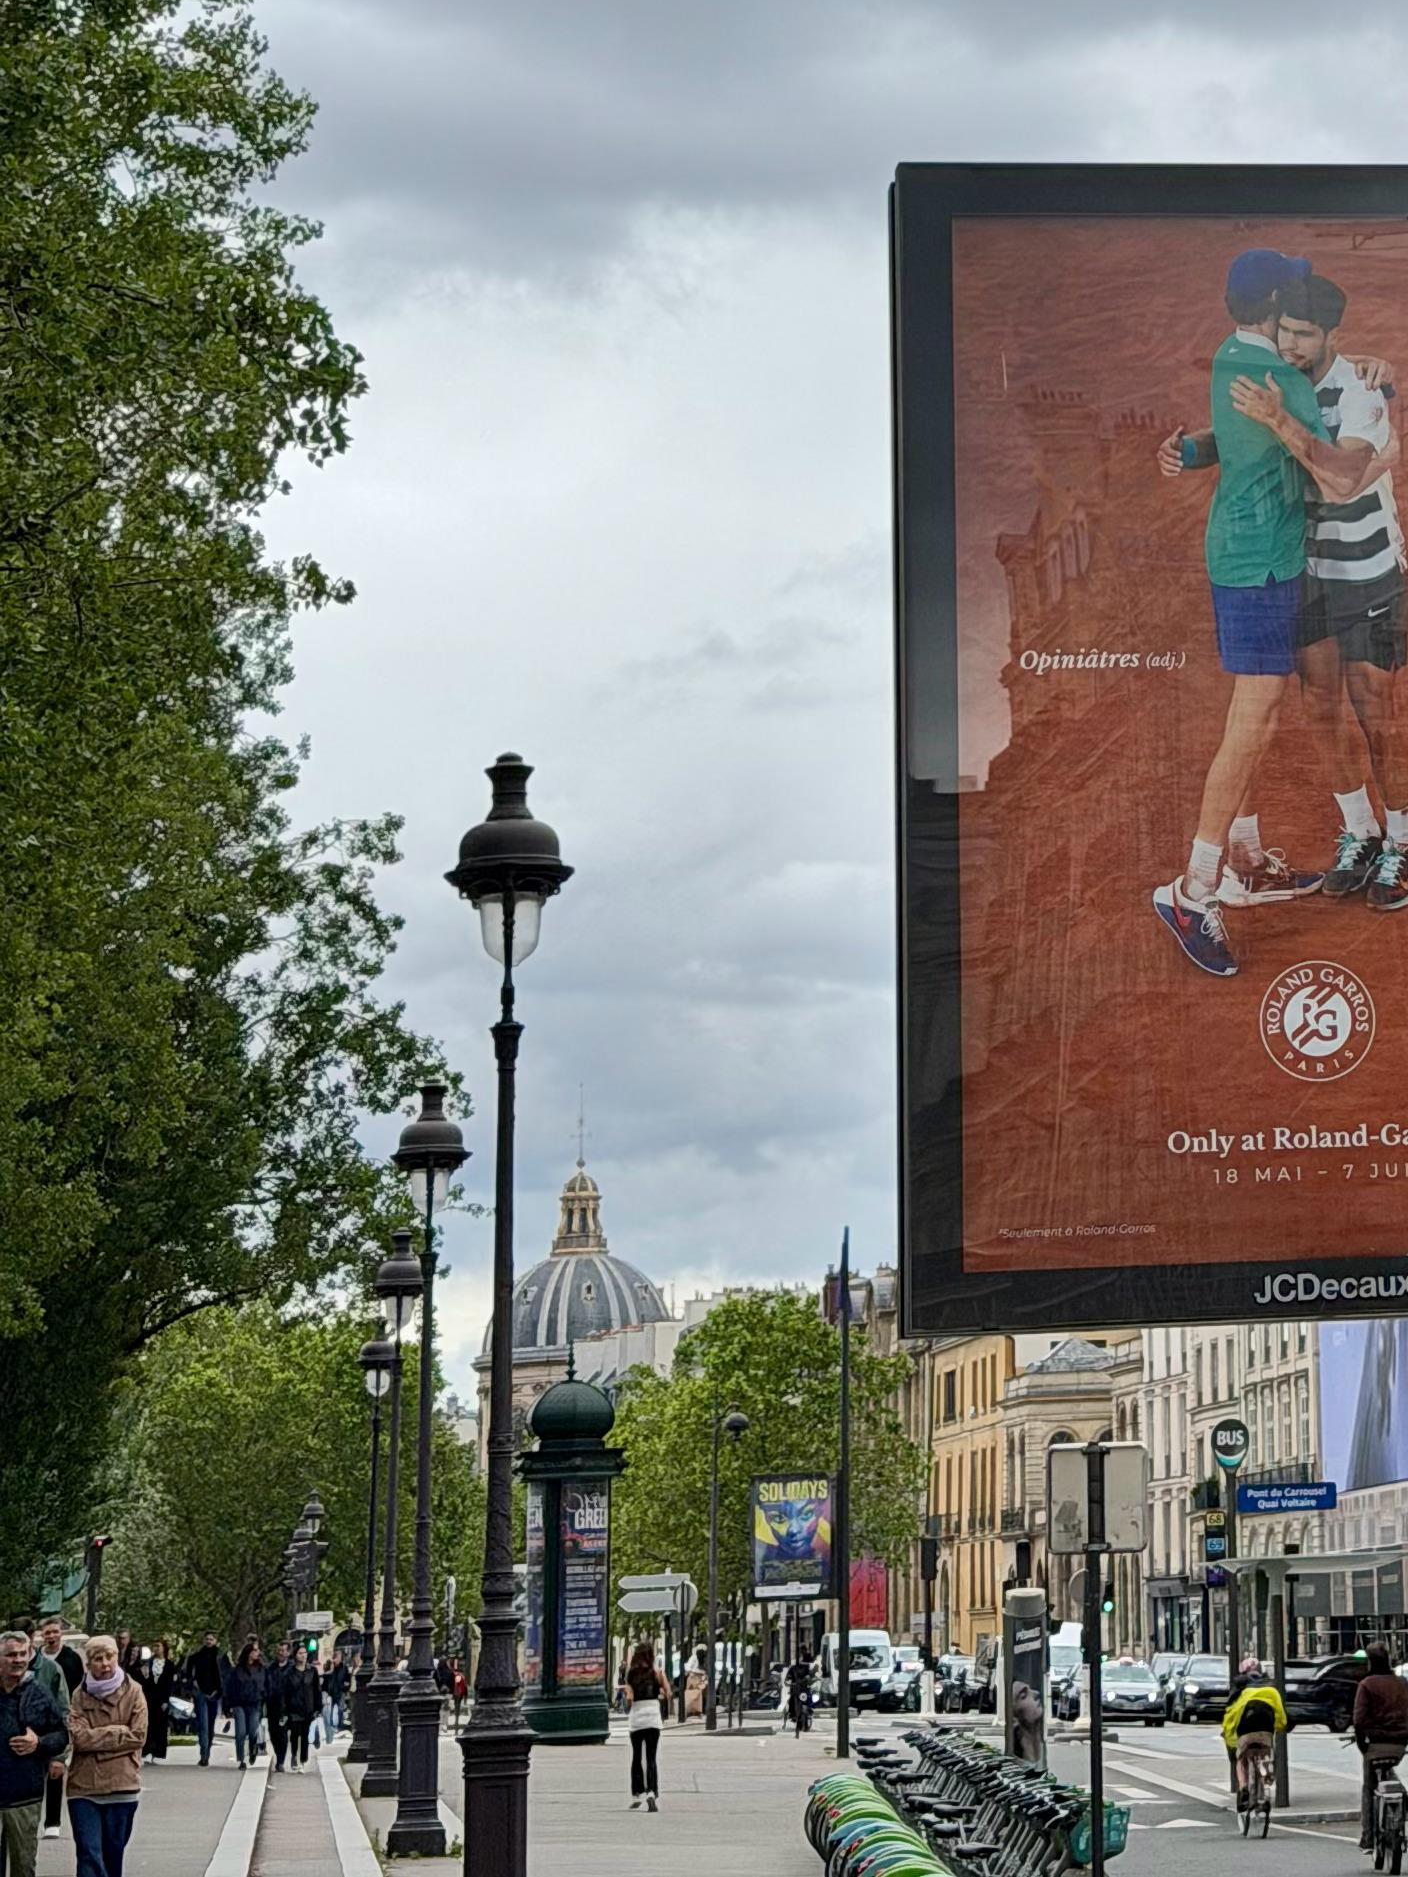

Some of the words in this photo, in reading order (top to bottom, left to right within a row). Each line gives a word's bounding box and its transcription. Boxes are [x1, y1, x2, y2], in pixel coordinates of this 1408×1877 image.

[1019, 648, 1141, 675] Opiniâtres
[1145, 651, 1187, 671] (adj.)
[1266, 968, 1314, 1036] ROLAND
[1320, 968, 1370, 1033] GARROS
[1284, 1049, 1354, 1073] PARIS
[1168, 1130, 1234, 1158] Only
[1241, 1131, 1266, 1150] at
[1213, 1169, 1238, 1184] 18
[1255, 1166, 1302, 1183] MAI
[1342, 1164, 1355, 1179] 7
[1216, 1430, 1245, 1446] BUS
[759, 1480, 828, 1502] SOLIDAYS
[1247, 1489, 1268, 1497] Pont
[1271, 1488, 1282, 1497] du
[1285, 1486, 1327, 1496] Carrousel
[1257, 1499, 1279, 1509] Quai
[1281, 1498, 1317, 1507] Voltaire
[1208, 1515, 1222, 1525] 68
[1208, 1539, 1223, 1550] 69
